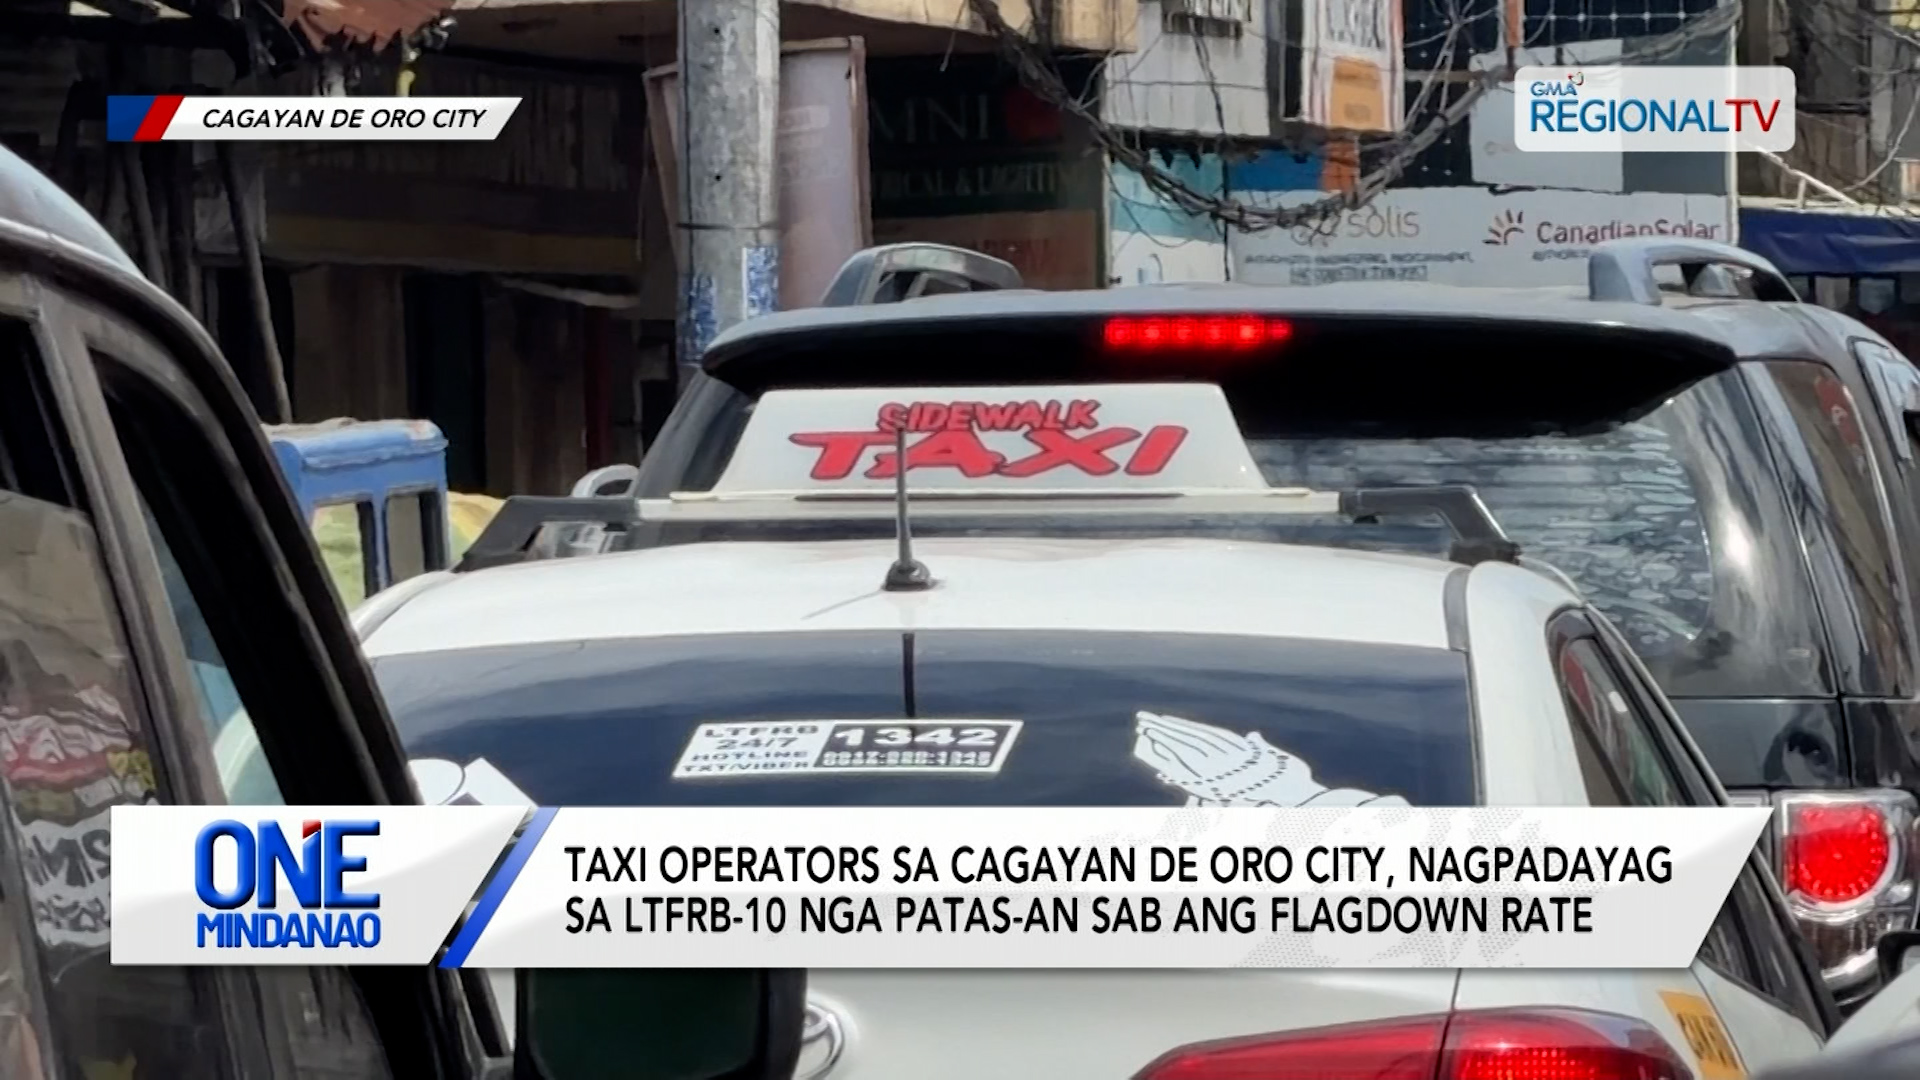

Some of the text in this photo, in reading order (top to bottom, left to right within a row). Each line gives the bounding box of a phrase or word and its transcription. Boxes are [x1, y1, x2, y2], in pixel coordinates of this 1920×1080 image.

[1347, 205, 1420, 238] solis
[877, 400, 1099, 432] SIDEWALK
[788, 425, 1188, 480] TAXI
[704, 725, 819, 738] LTFRB
[834, 727, 998, 747] 1342
[715, 737, 798, 751] 24/7
[691, 750, 808, 763] HOTLINE
